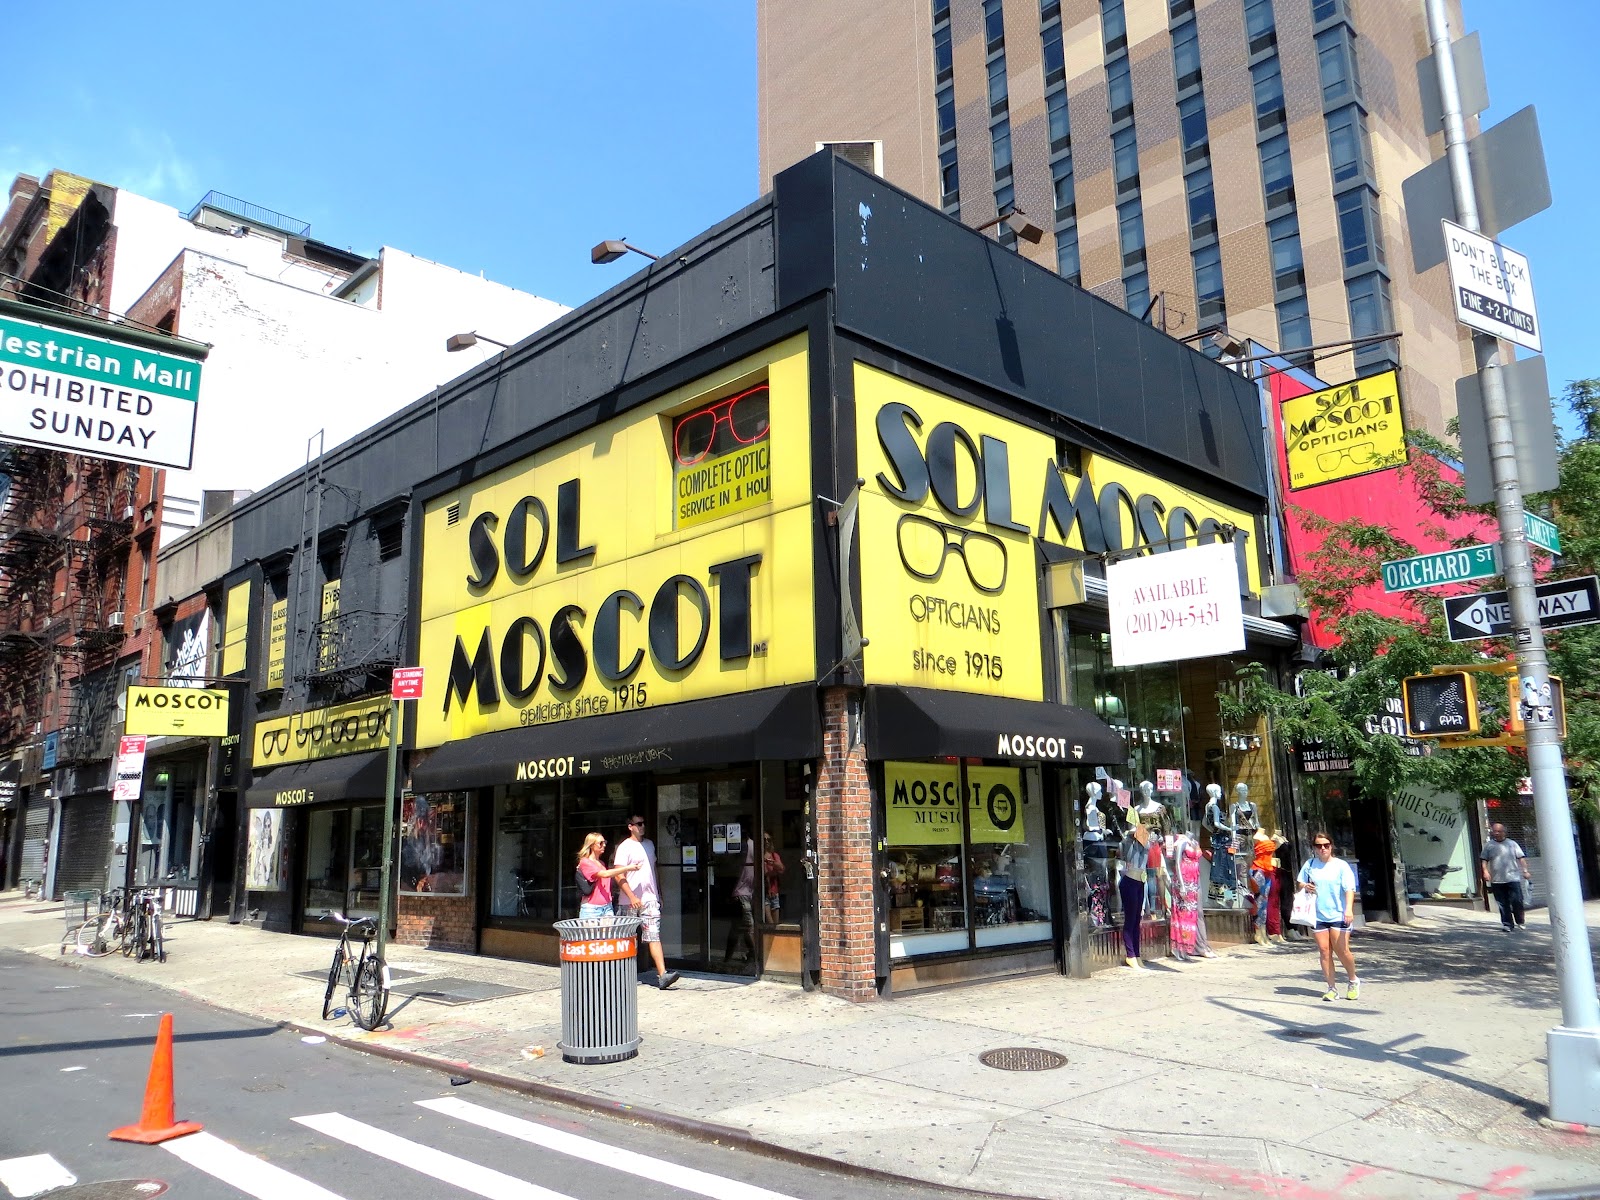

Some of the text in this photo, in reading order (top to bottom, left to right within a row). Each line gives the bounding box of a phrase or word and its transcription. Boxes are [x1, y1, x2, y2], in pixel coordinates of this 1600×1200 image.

[1452, 238, 1526, 282] DON'T BLOCK
[1470, 264, 1518, 296] THE BOX
[1462, 290, 1533, 331] FINE +2 POINTS
[133, 359, 192, 391] Mall
[1316, 384, 1367, 412] SOL
[30, 408, 157, 450] SUNDAY
[1290, 395, 1396, 441] MOSCOT
[1300, 420, 1389, 451] OPTICIANS
[680, 460, 731, 498] COMPLETE
[875, 401, 1031, 535] SOL
[1294, 472, 1304, 480] 118
[680, 494, 715, 520] SERVICE
[719, 489, 730, 507] IN
[734, 485, 742, 502] 1
[466, 478, 597, 589] SOL
[1549, 526, 1557, 540] ST
[1386, 548, 1493, 590] ORCHARD ST
[1133, 576, 1209, 606] AVAILABLE
[909, 594, 1001, 635] OPTICIANS
[1470, 593, 1578, 626] ONE WAY
[443, 554, 762, 713] MOSCOT
[394, 670, 423, 679] NO STANDING
[912, 647, 1003, 682] since 1915
[397, 679, 419, 687] ANYTIME
[135, 693, 223, 710] MOSCOT
[520, 682, 647, 726] opticians since 1915
[1381, 697, 1404, 714] OR
[997, 733, 1067, 758] MOSCOT
[516, 756, 575, 781] MOSCOT
[275, 788, 307, 805] MOSCOT
[892, 779, 981, 806] MOSCT
[565, 943, 587, 955] East
[588, 941, 614, 956] Side
[616, 939, 629, 953] NY
